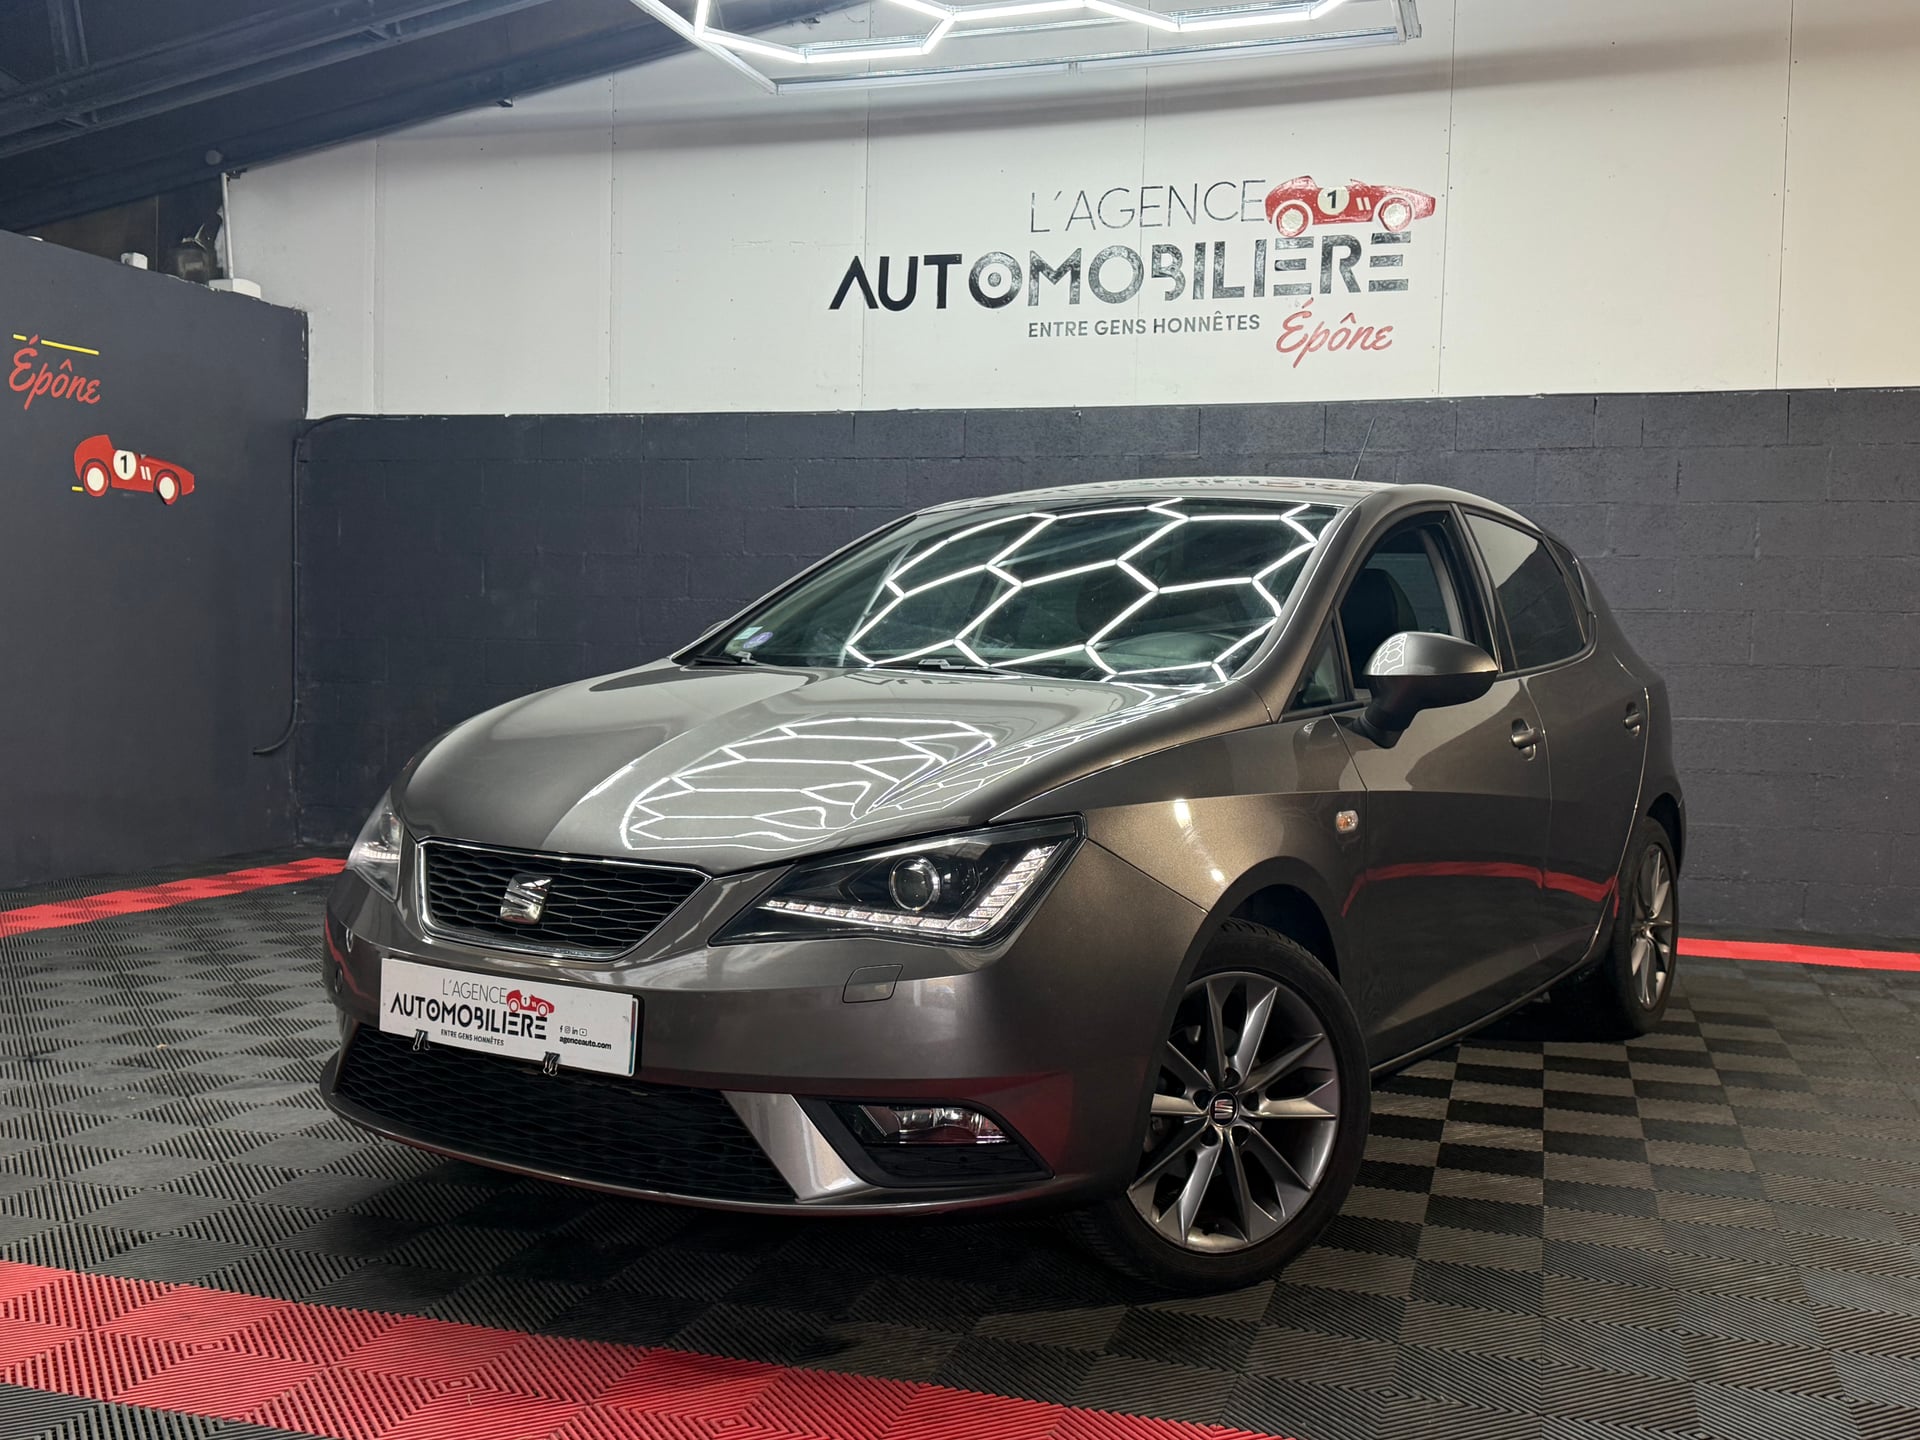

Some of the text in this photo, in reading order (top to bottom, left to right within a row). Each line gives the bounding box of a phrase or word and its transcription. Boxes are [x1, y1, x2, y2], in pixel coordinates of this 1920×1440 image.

[1325, 189, 1340, 211] 1
[1028, 310, 1261, 338] ENTRE GENS HONNÊTES
[1275, 297, 1393, 369] Épône
[8, 334, 101, 411] Épône
[120, 454, 128, 474] 1
[441, 1028, 504, 1046] ENTRE GENS HONNÊTES
